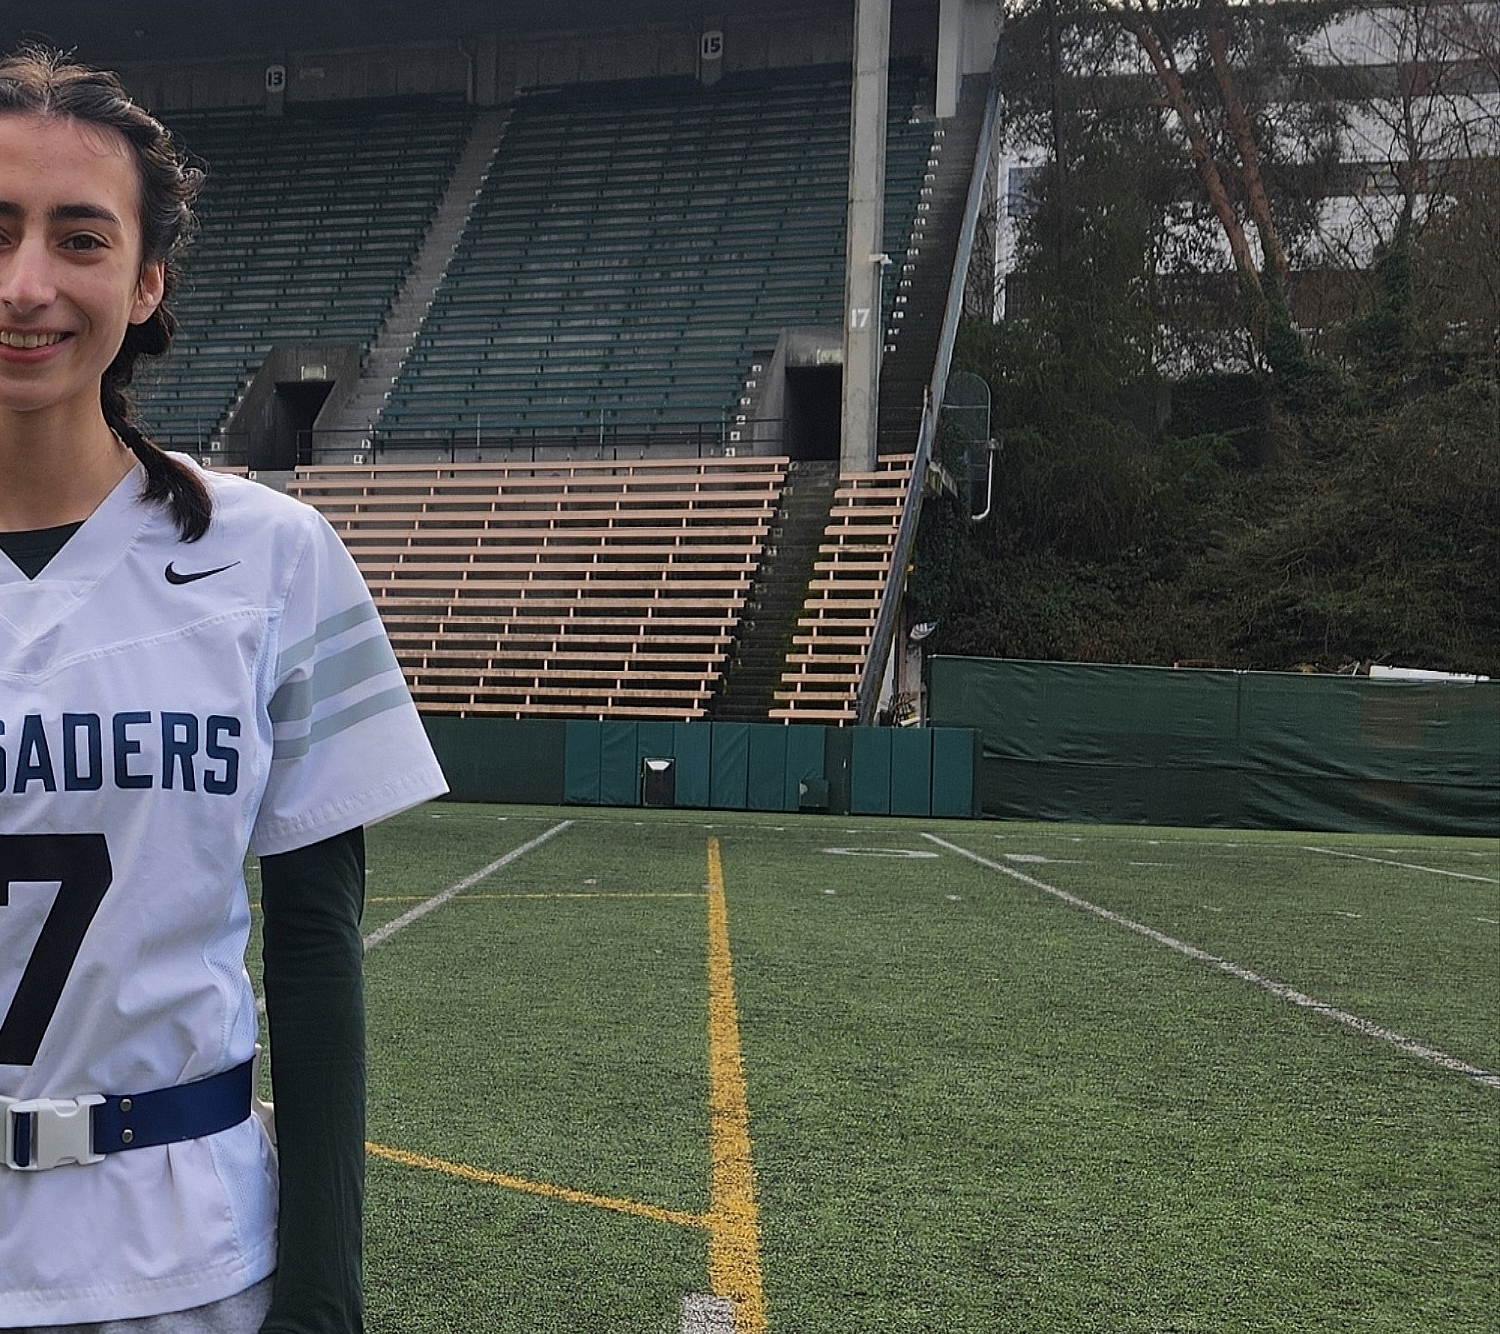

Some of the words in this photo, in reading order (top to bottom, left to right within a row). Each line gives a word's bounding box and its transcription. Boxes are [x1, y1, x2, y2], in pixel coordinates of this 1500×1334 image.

[703, 37, 721, 54] 15
[267, 71, 283, 87] 13
[851, 308, 871, 328] 17
